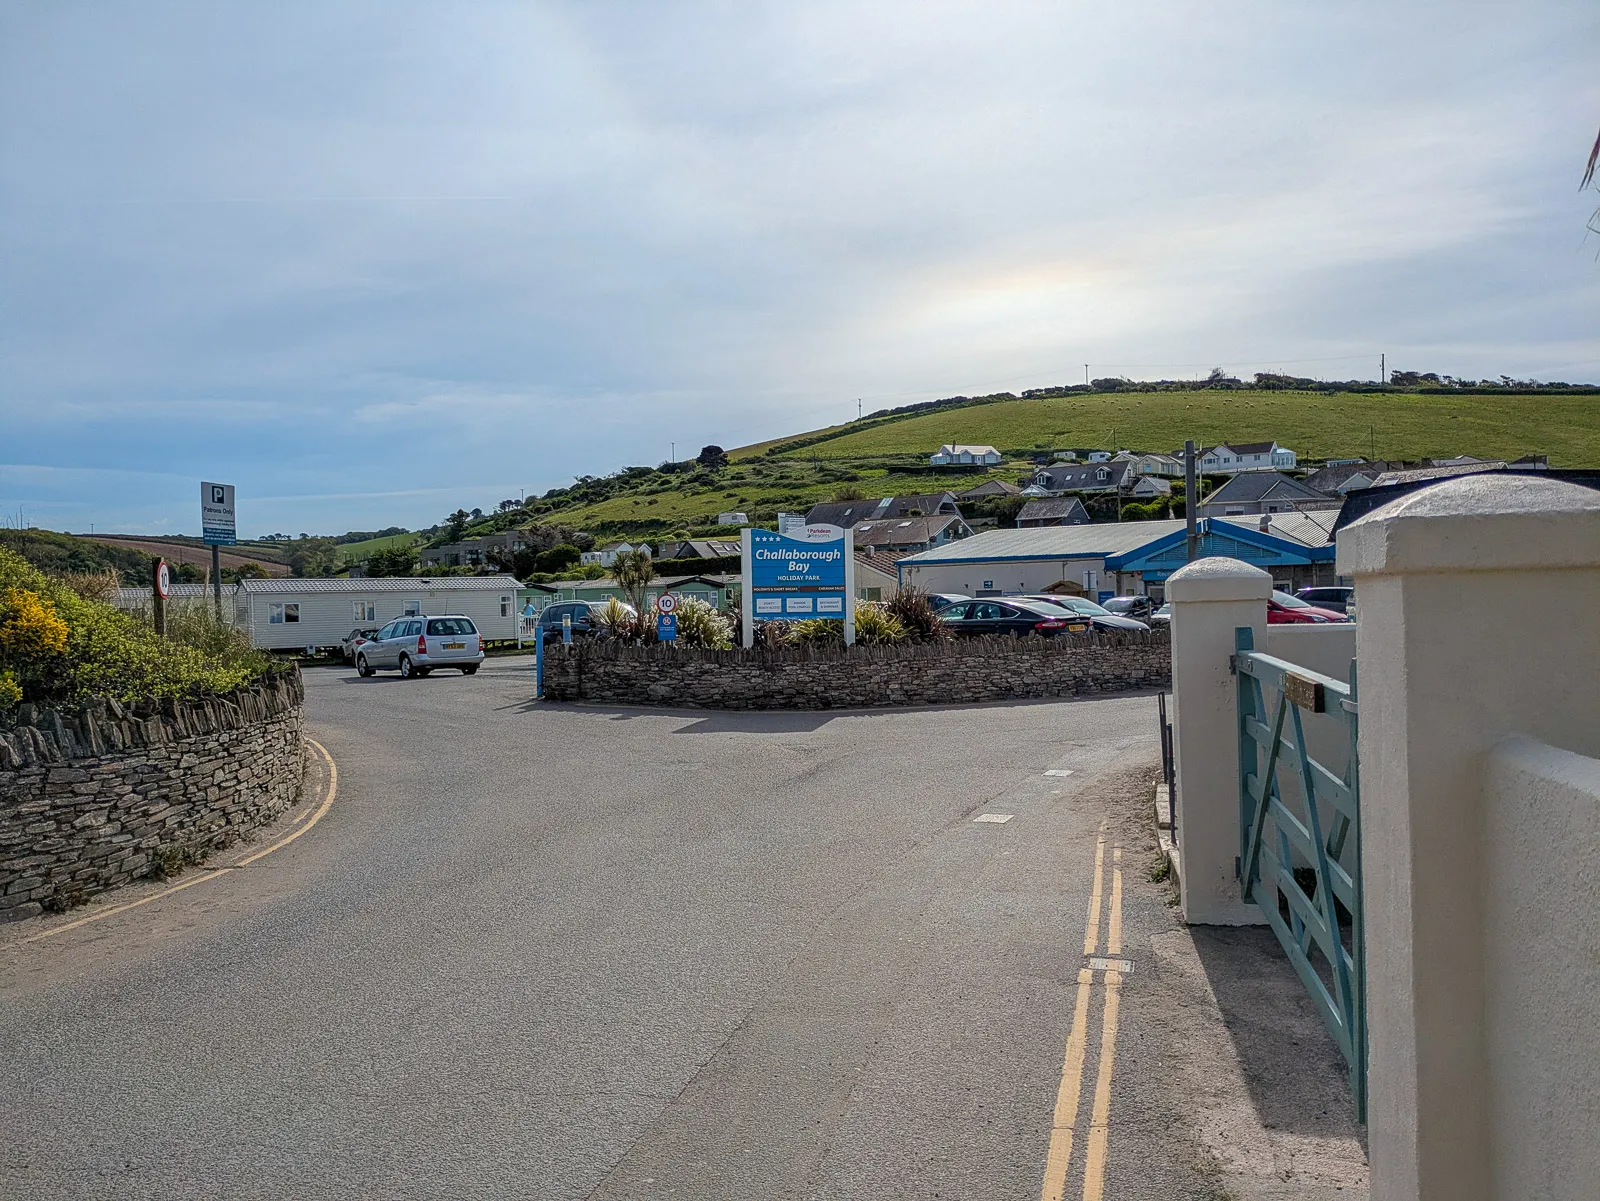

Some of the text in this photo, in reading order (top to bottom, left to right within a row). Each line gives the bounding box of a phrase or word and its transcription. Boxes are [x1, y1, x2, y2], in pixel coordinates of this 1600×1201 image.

[213, 487, 223, 502] P
[756, 549, 840, 562] Challaborough
[788, 561, 810, 573] Bay
[161, 572, 167, 588] 10
